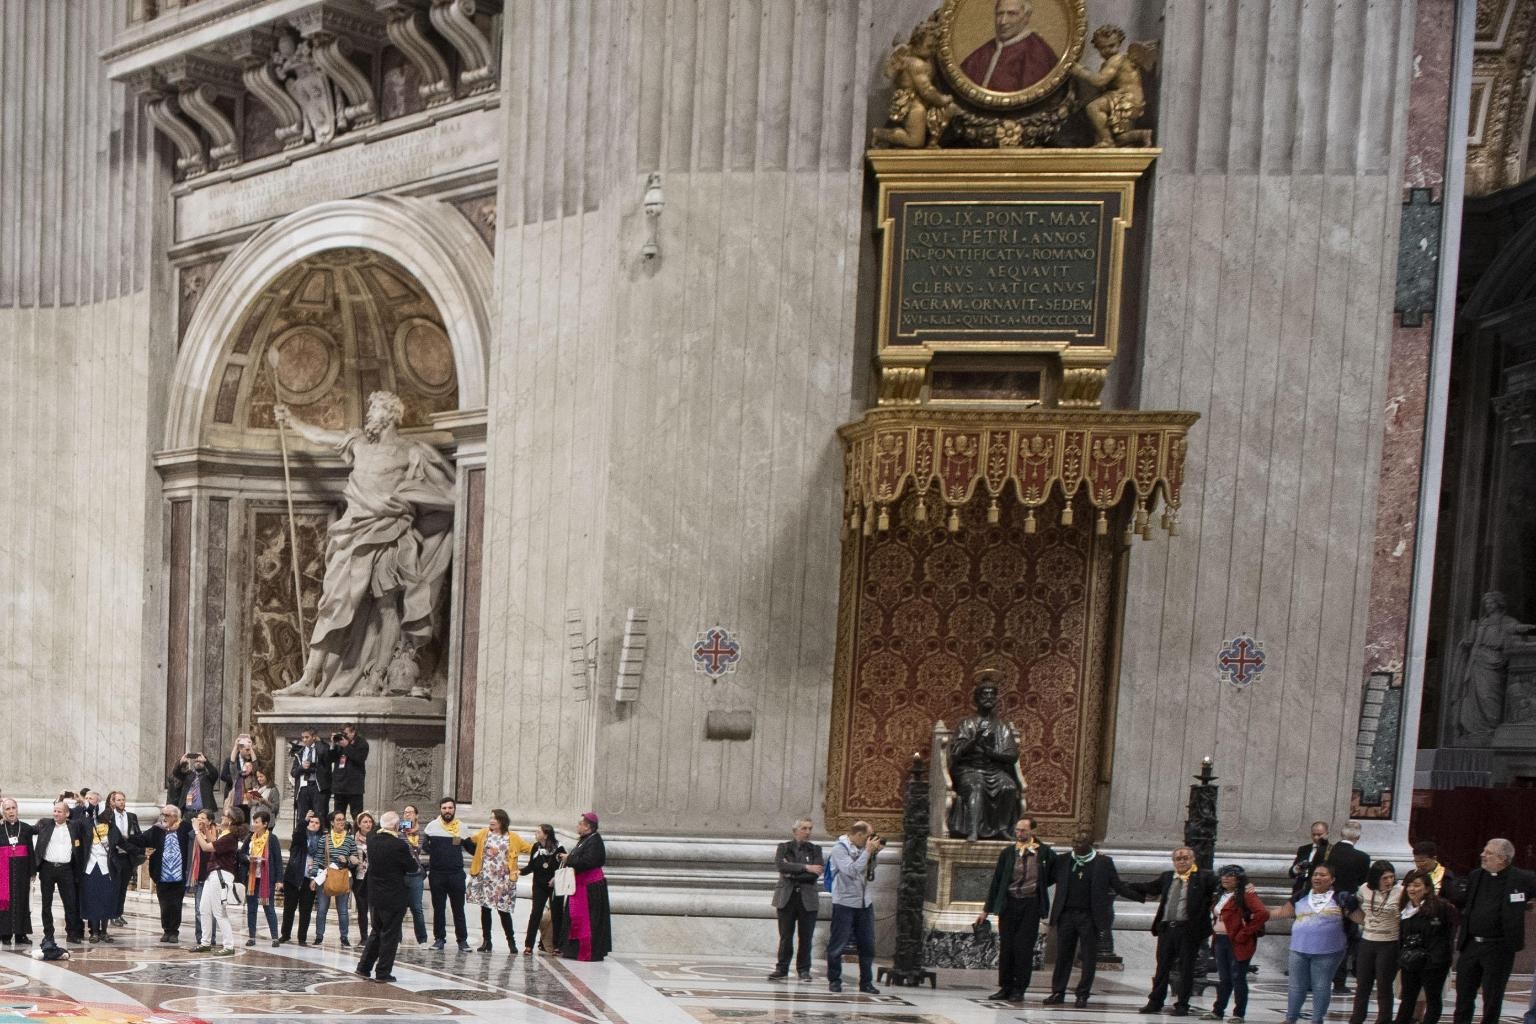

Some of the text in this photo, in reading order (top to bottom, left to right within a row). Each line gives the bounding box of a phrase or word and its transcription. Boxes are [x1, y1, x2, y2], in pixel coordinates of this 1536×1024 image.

[913, 211, 943, 226] PIO
[985, 211, 1039, 226] PONT
[1050, 211, 1090, 226] MAX
[961, 229, 1018, 243] PETRI
[1032, 232, 1087, 243] ANNOS
[1032, 248, 1095, 260] ROMANO
[930, 264, 1071, 281] VNVS AEQVAVIT
[912, 282, 1085, 294] CLERVS VATICANVS
[903, 298, 1092, 312] SACRAM ORNAVIT SEDEM
